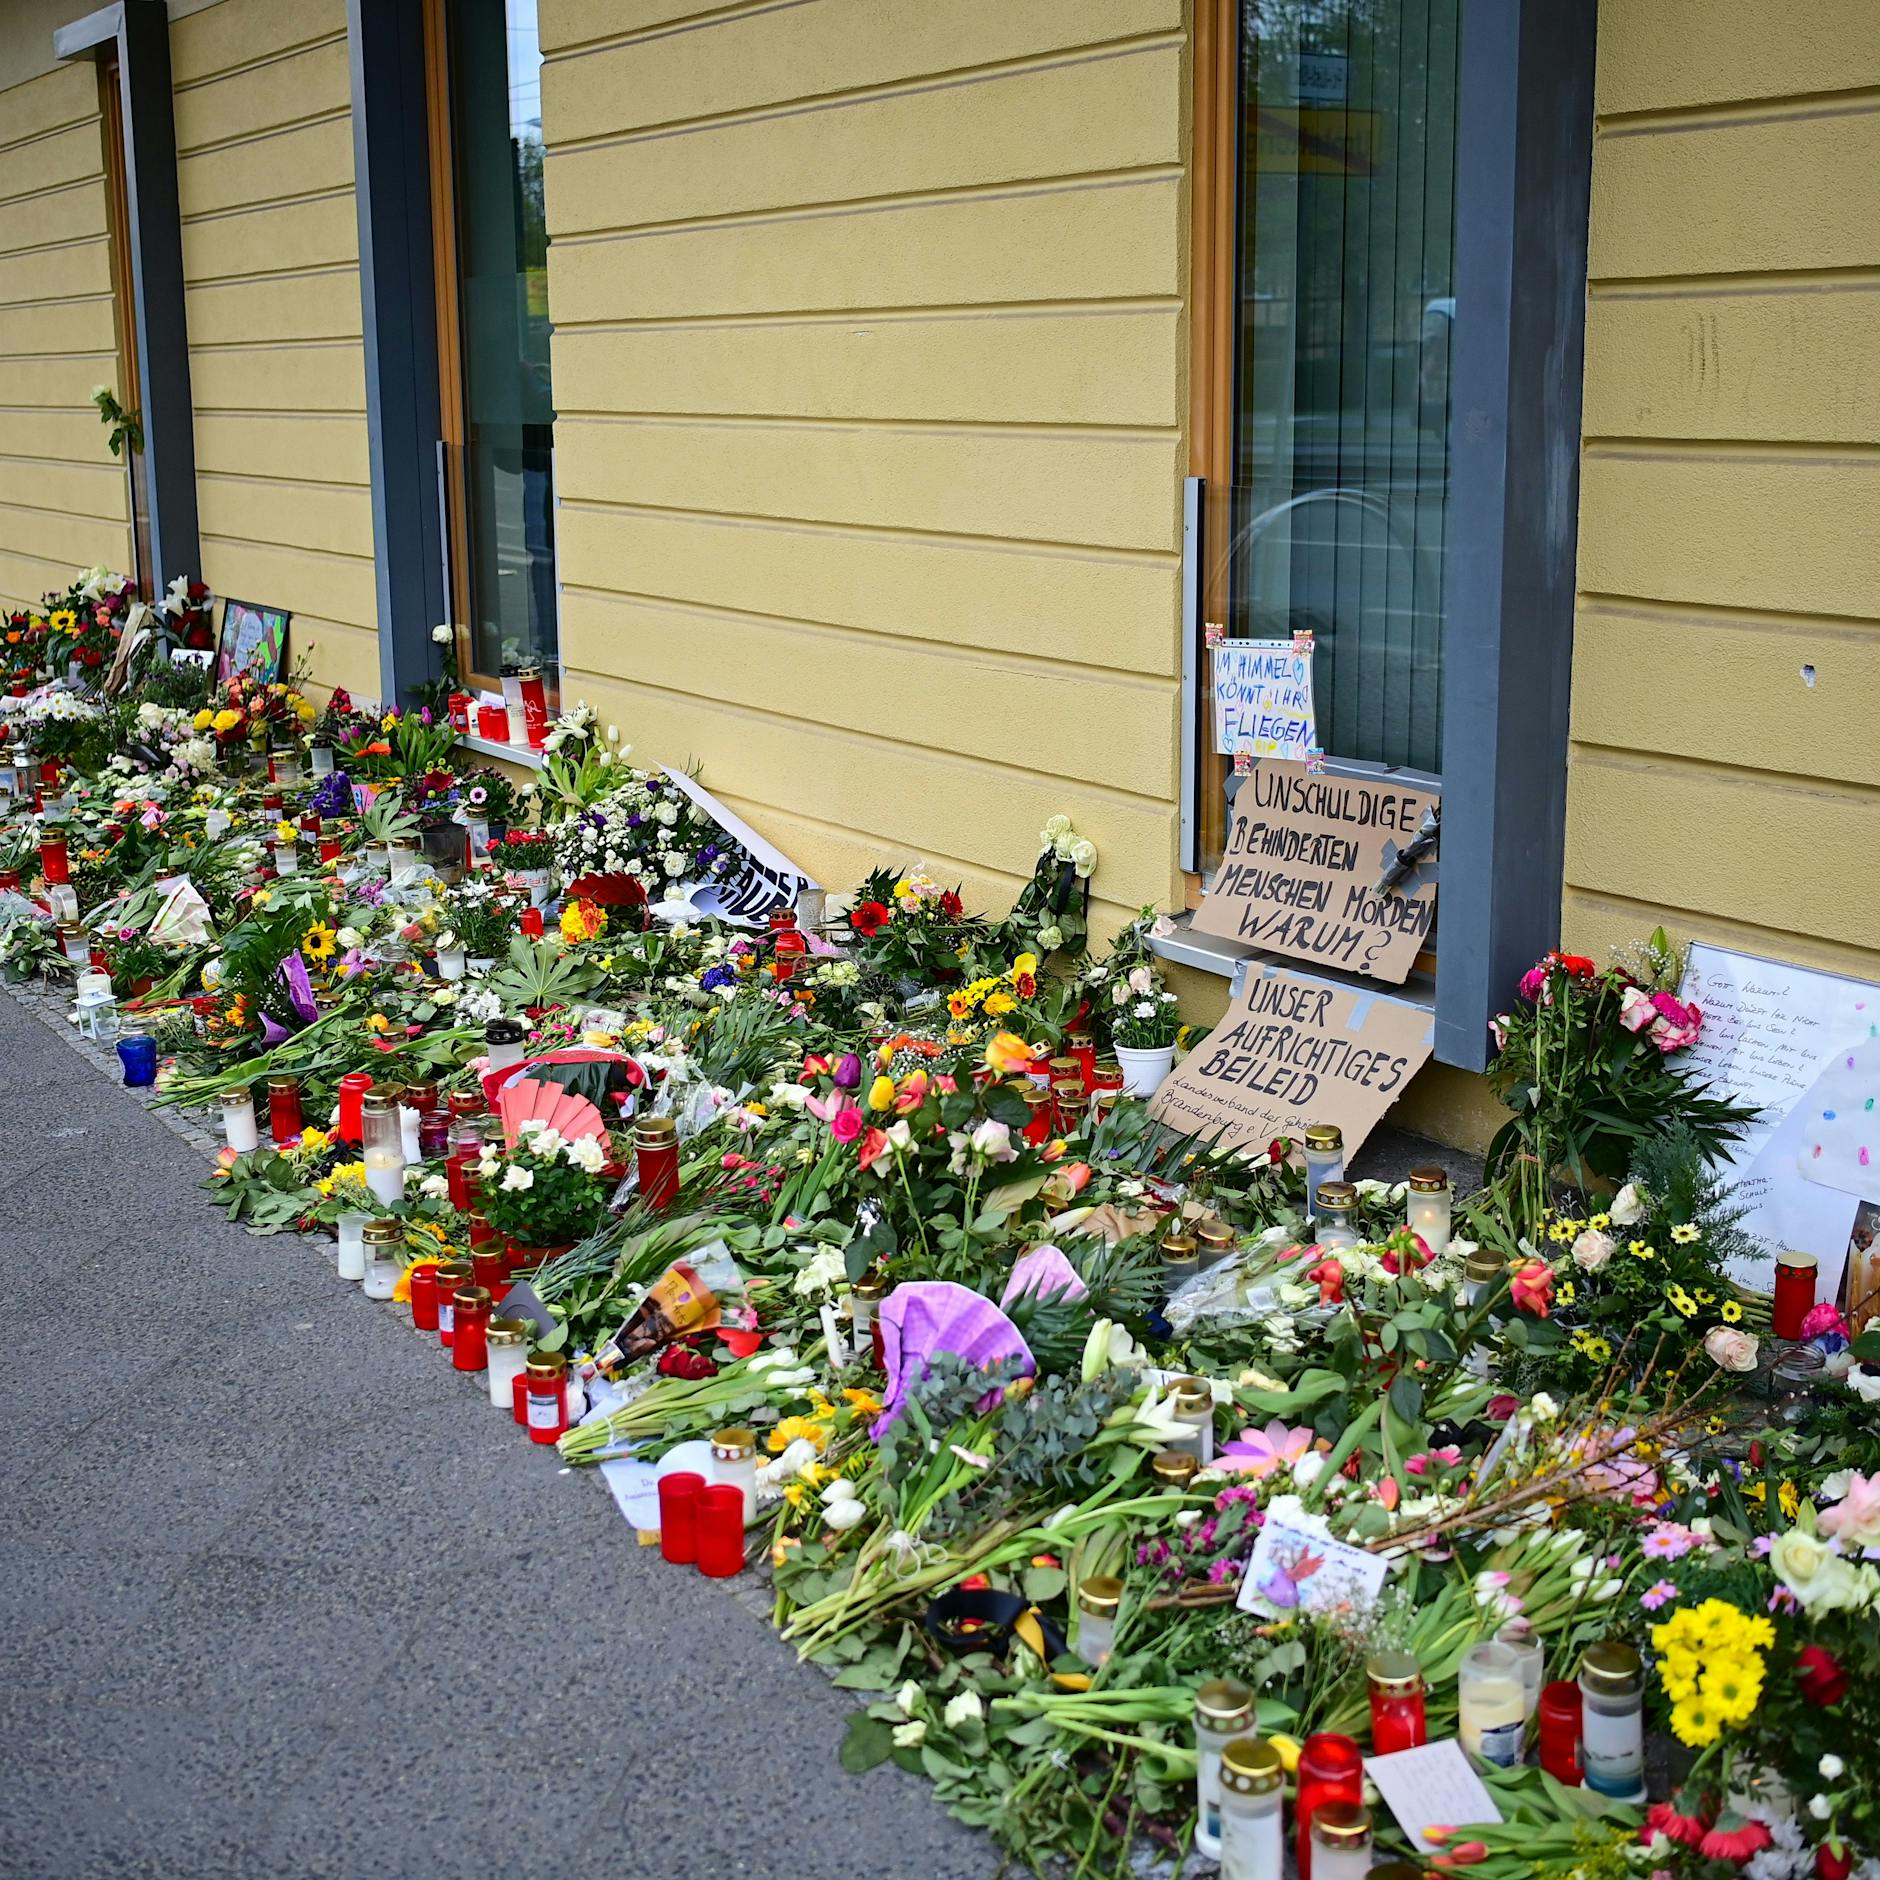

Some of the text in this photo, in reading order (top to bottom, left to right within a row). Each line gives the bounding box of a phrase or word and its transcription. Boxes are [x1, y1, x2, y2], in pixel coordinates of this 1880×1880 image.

[1216, 652, 1292, 679] IM HIMMEL
[1216, 675, 1265, 704] KÖNNT
[1224, 708, 1315, 747] FLIEGEN
[1254, 769, 1417, 833] UNSCHULDIGE
[1229, 815, 1359, 872] BEHINDERTEN
[1214, 863, 1333, 913] MENSCHEN
[1247, 978, 1333, 1027] UNSER
[1199, 1049, 1319, 1106] BEILEID
[1218, 1020, 1408, 1094] AUFRICHTIGES
[1161, 1088, 1244, 1139] Brandenburg
[1172, 1075, 1260, 1116] Landesverband
[1260, 1109, 1281, 1124] der
